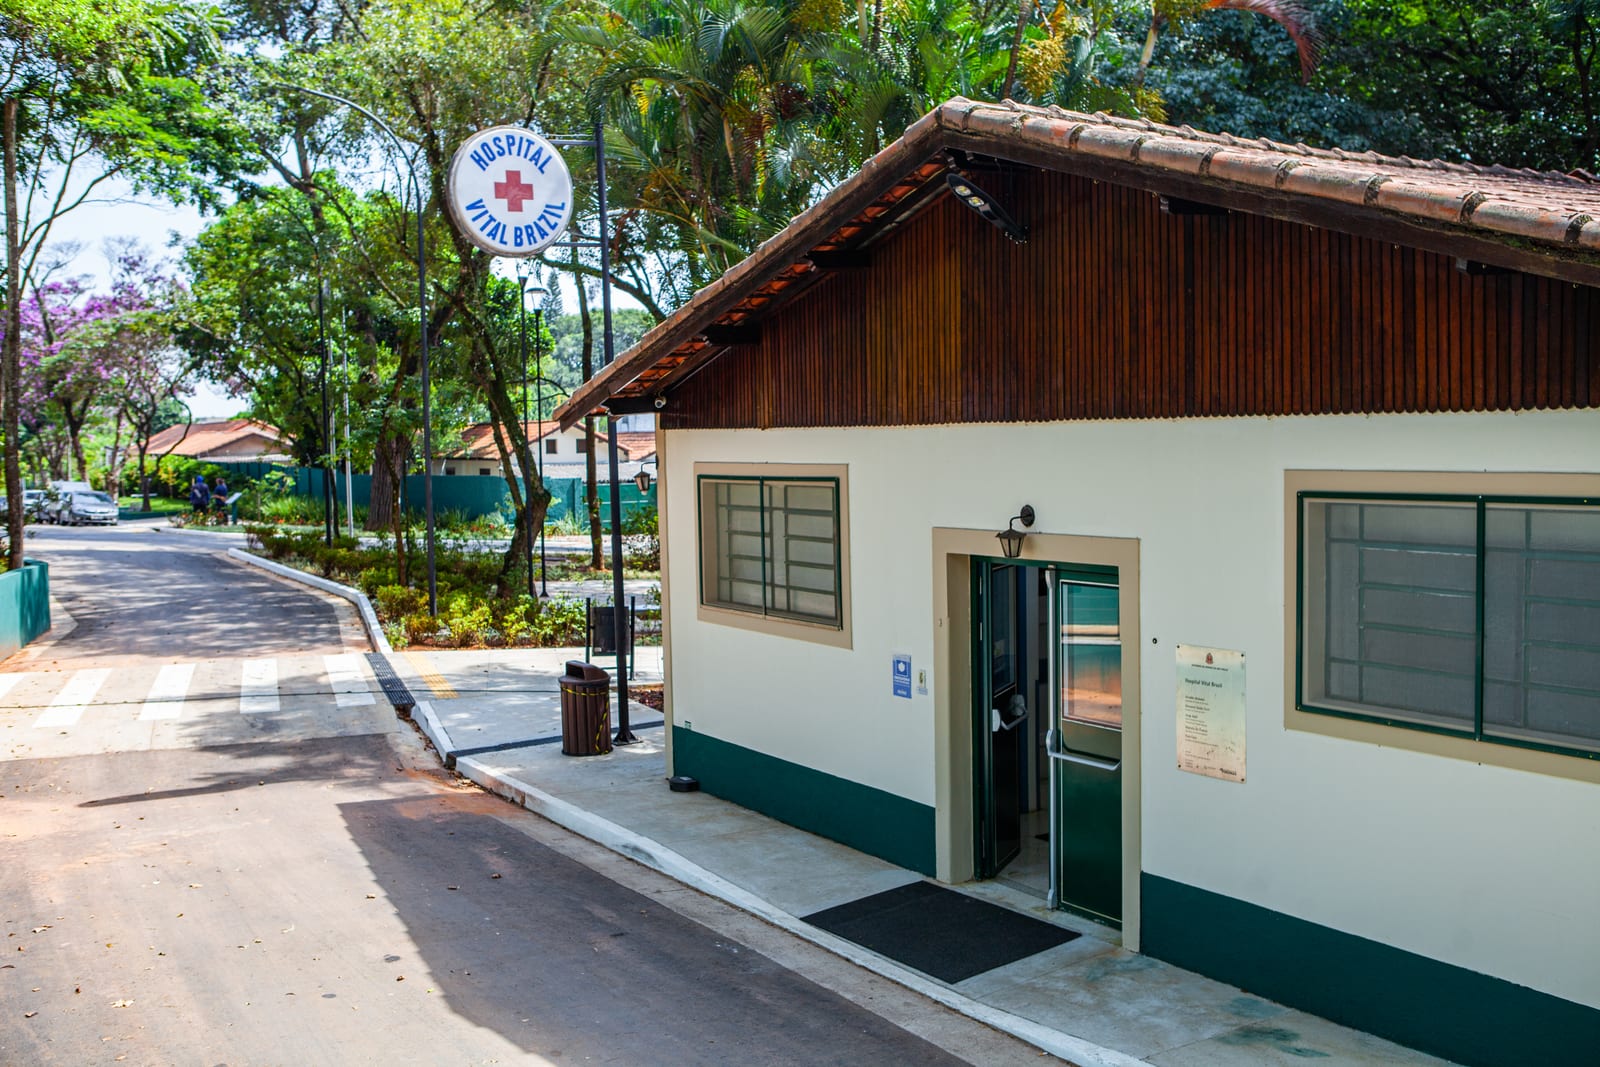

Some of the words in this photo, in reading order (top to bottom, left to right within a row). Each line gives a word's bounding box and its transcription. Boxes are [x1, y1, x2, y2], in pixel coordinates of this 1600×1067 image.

[470, 134, 552, 174] HOSPITAL
[465, 198, 508, 245] VITAL
[513, 202, 566, 247] BRAZIL
